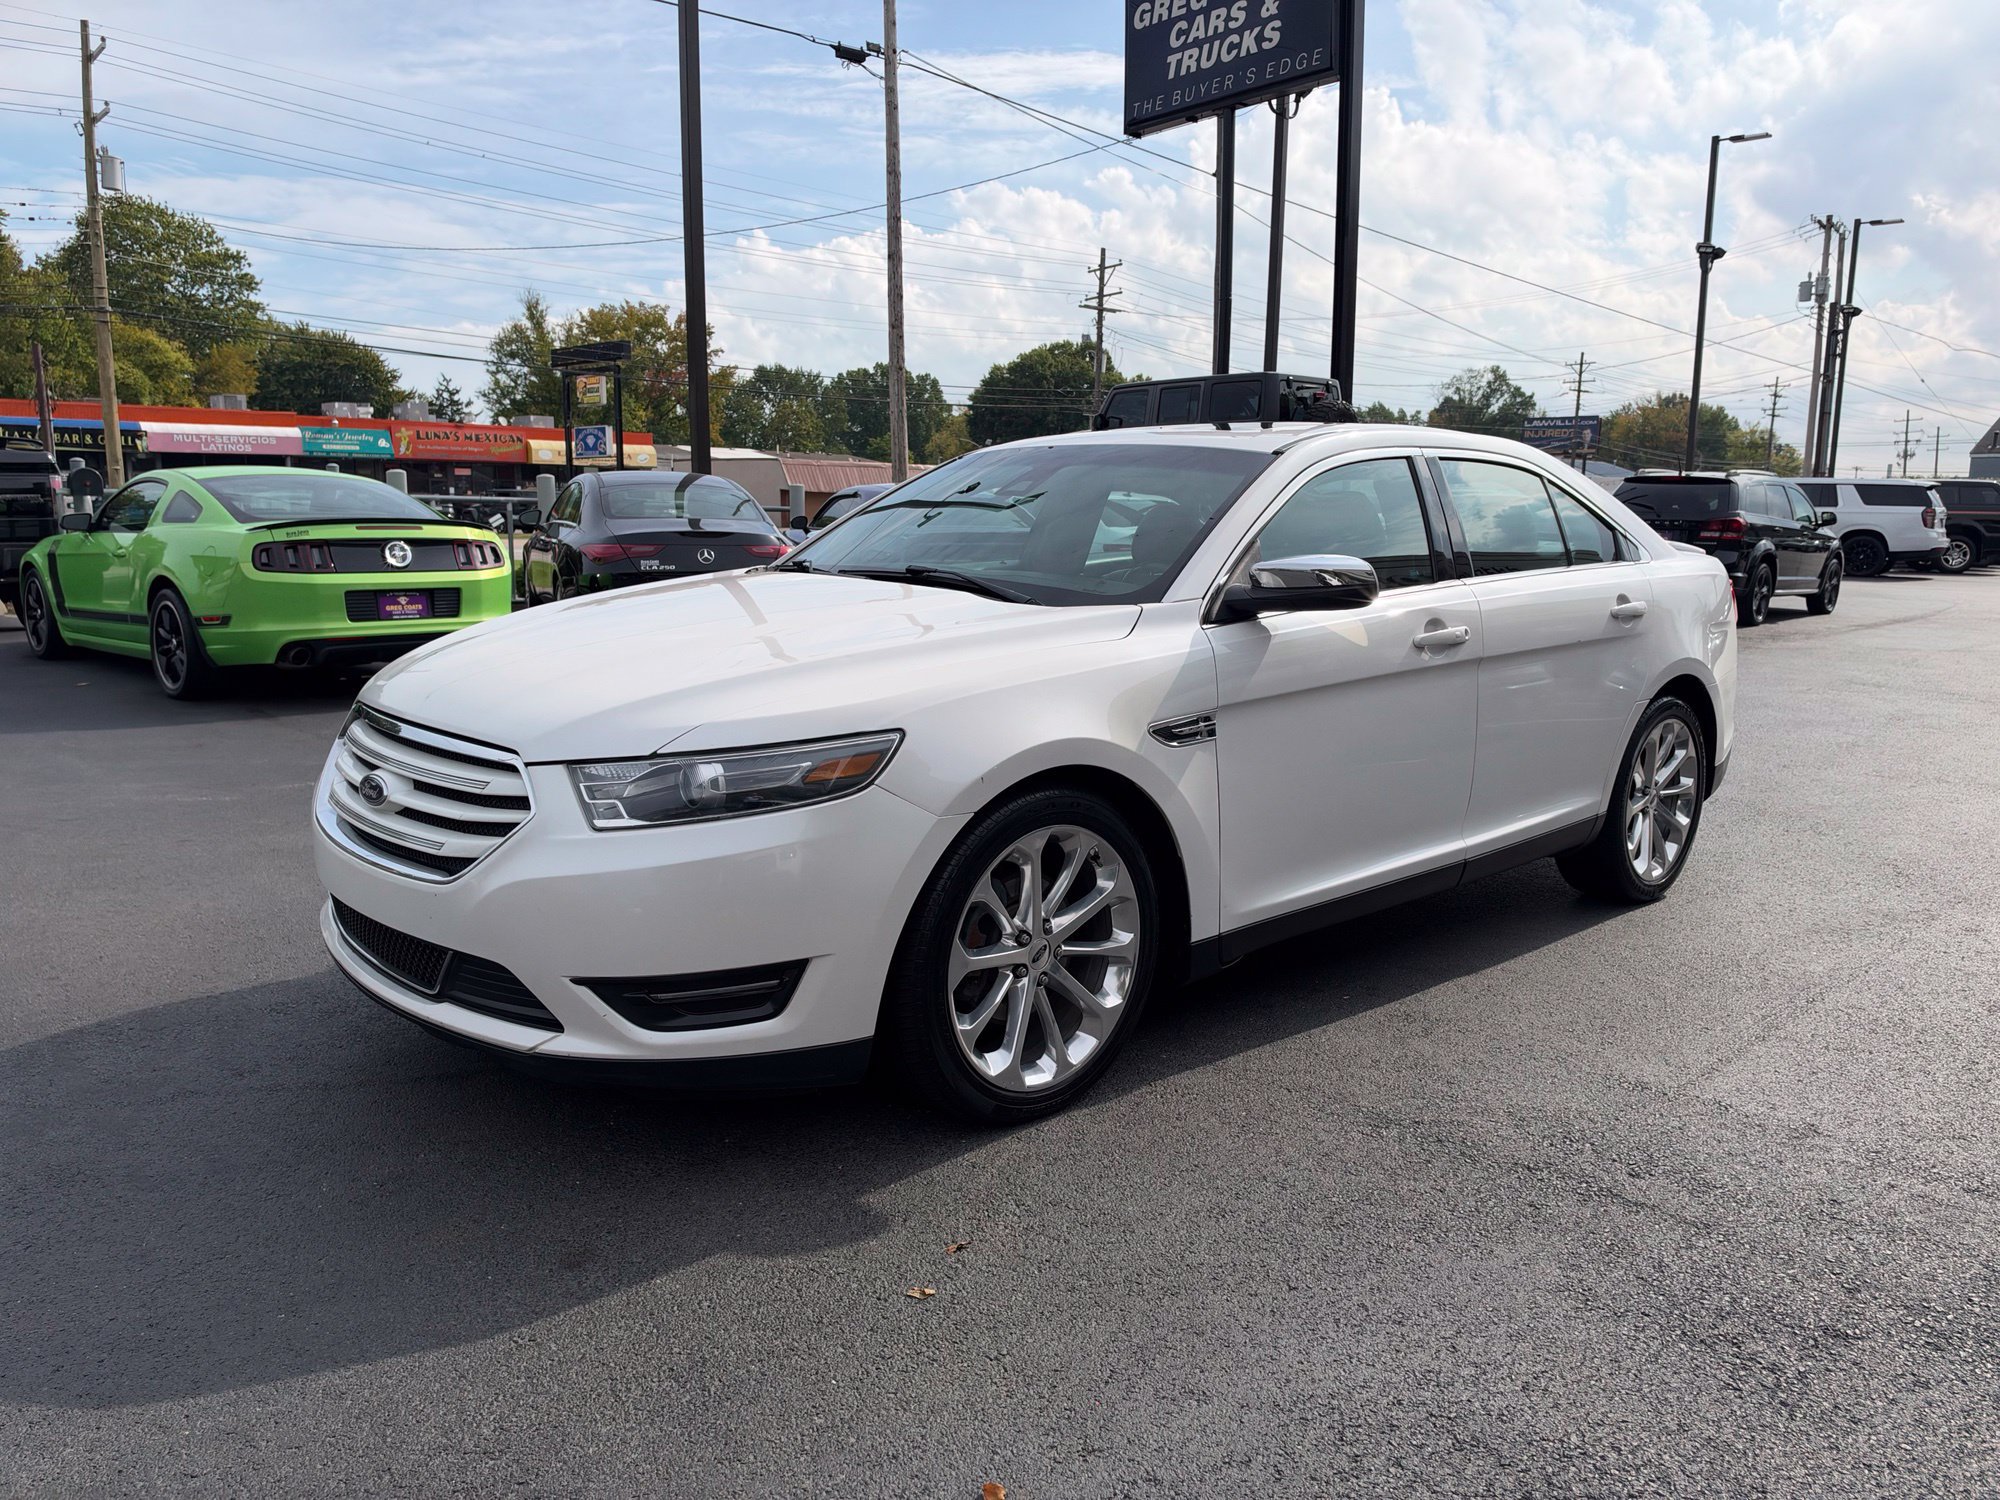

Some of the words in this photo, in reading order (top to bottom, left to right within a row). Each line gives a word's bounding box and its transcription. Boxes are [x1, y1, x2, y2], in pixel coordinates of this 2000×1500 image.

[1169, 0, 1247, 48] CARS
[1166, 20, 1282, 80] TRUCKS
[1133, 95, 1164, 118] THE
[1171, 67, 1257, 106] BUYER'S
[1265, 48, 1323, 79] EDGE
[54, 433, 80, 444] BAR
[84, 434, 93, 444] &
[173, 434, 277, 445] MULTI-SERVICIOS
[416, 429, 460, 442] LUNA'S
[464, 432, 524, 444] MEXICAN
[201, 443, 252, 452] LATINOS
[362, 779, 380, 799] Ford
